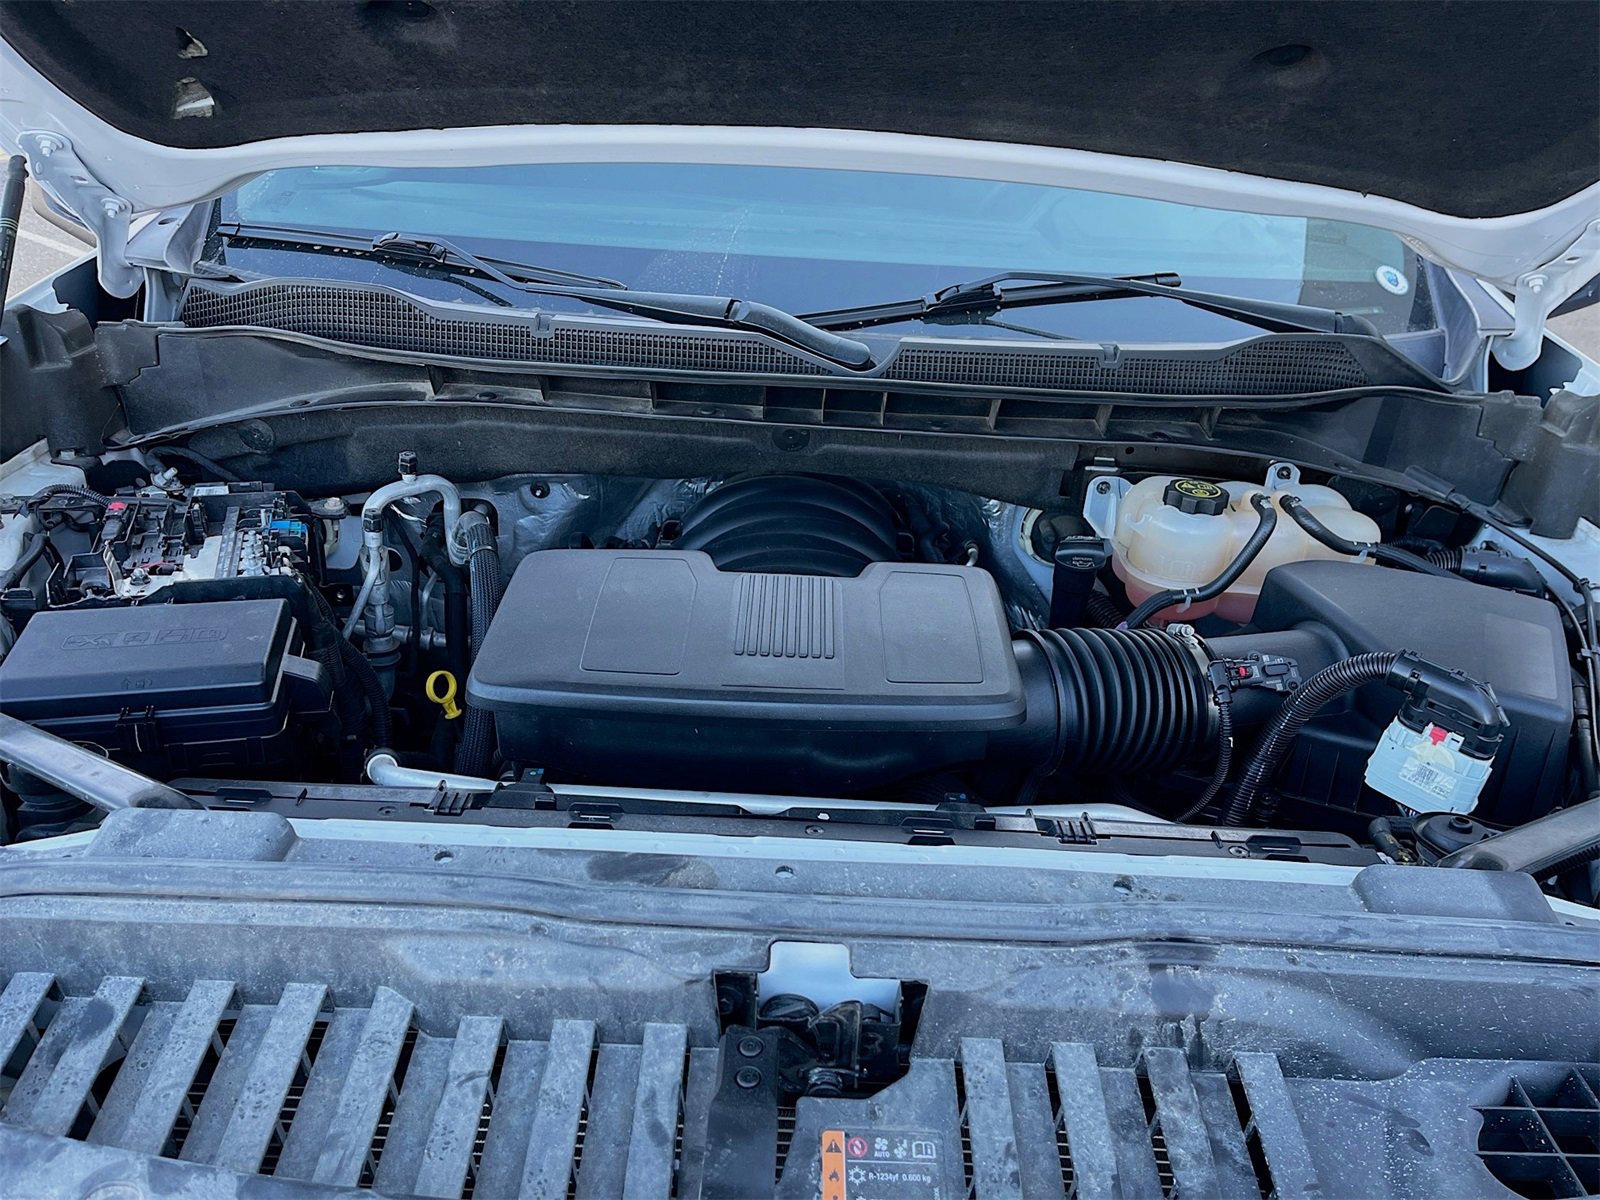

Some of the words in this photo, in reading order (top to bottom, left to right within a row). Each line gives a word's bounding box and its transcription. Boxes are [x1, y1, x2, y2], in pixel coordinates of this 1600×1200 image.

[868, 1172, 899, 1182] R-1234yf
[902, 1173, 921, 1182] 0.600
[922, 1174, 931, 1184] kg
